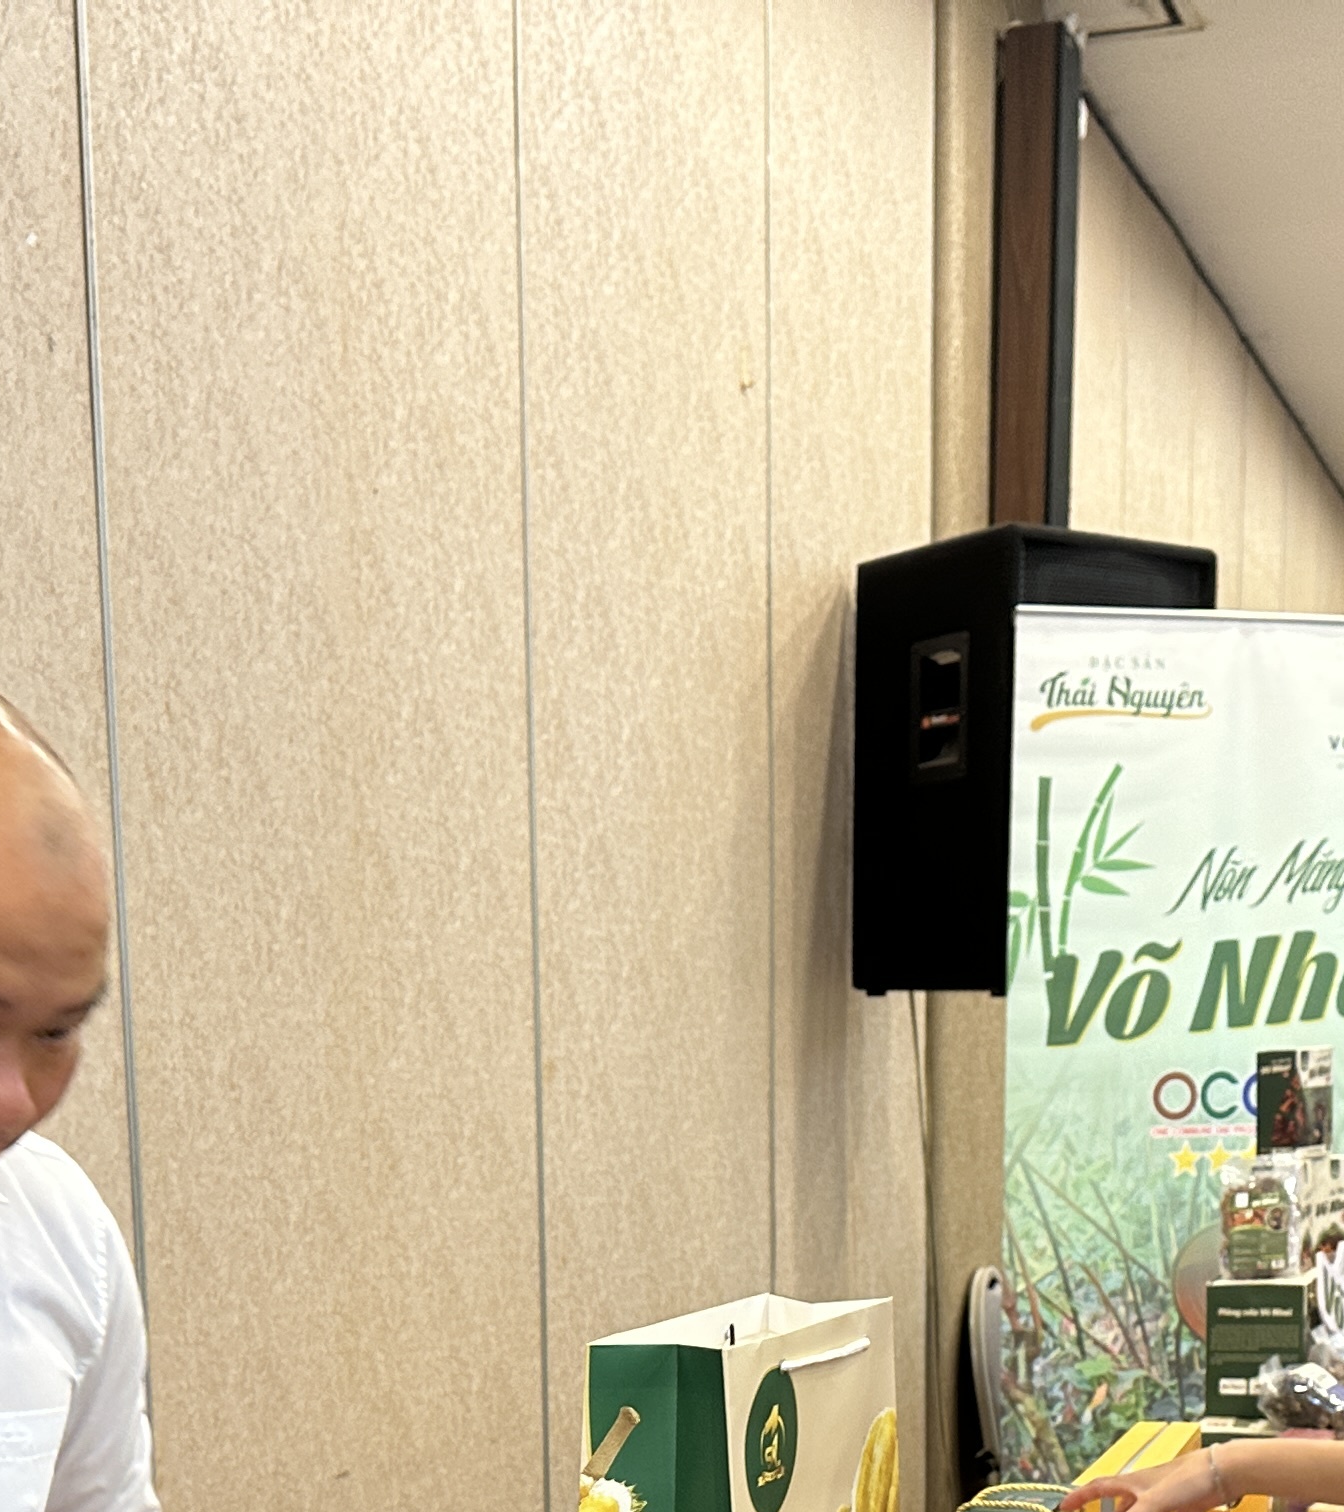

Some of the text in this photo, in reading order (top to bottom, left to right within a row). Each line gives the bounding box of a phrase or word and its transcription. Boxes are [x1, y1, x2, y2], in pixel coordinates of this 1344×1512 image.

[1039, 671, 1207, 718] Thái Nguyên
[1046, 939, 1183, 1047] Võ
